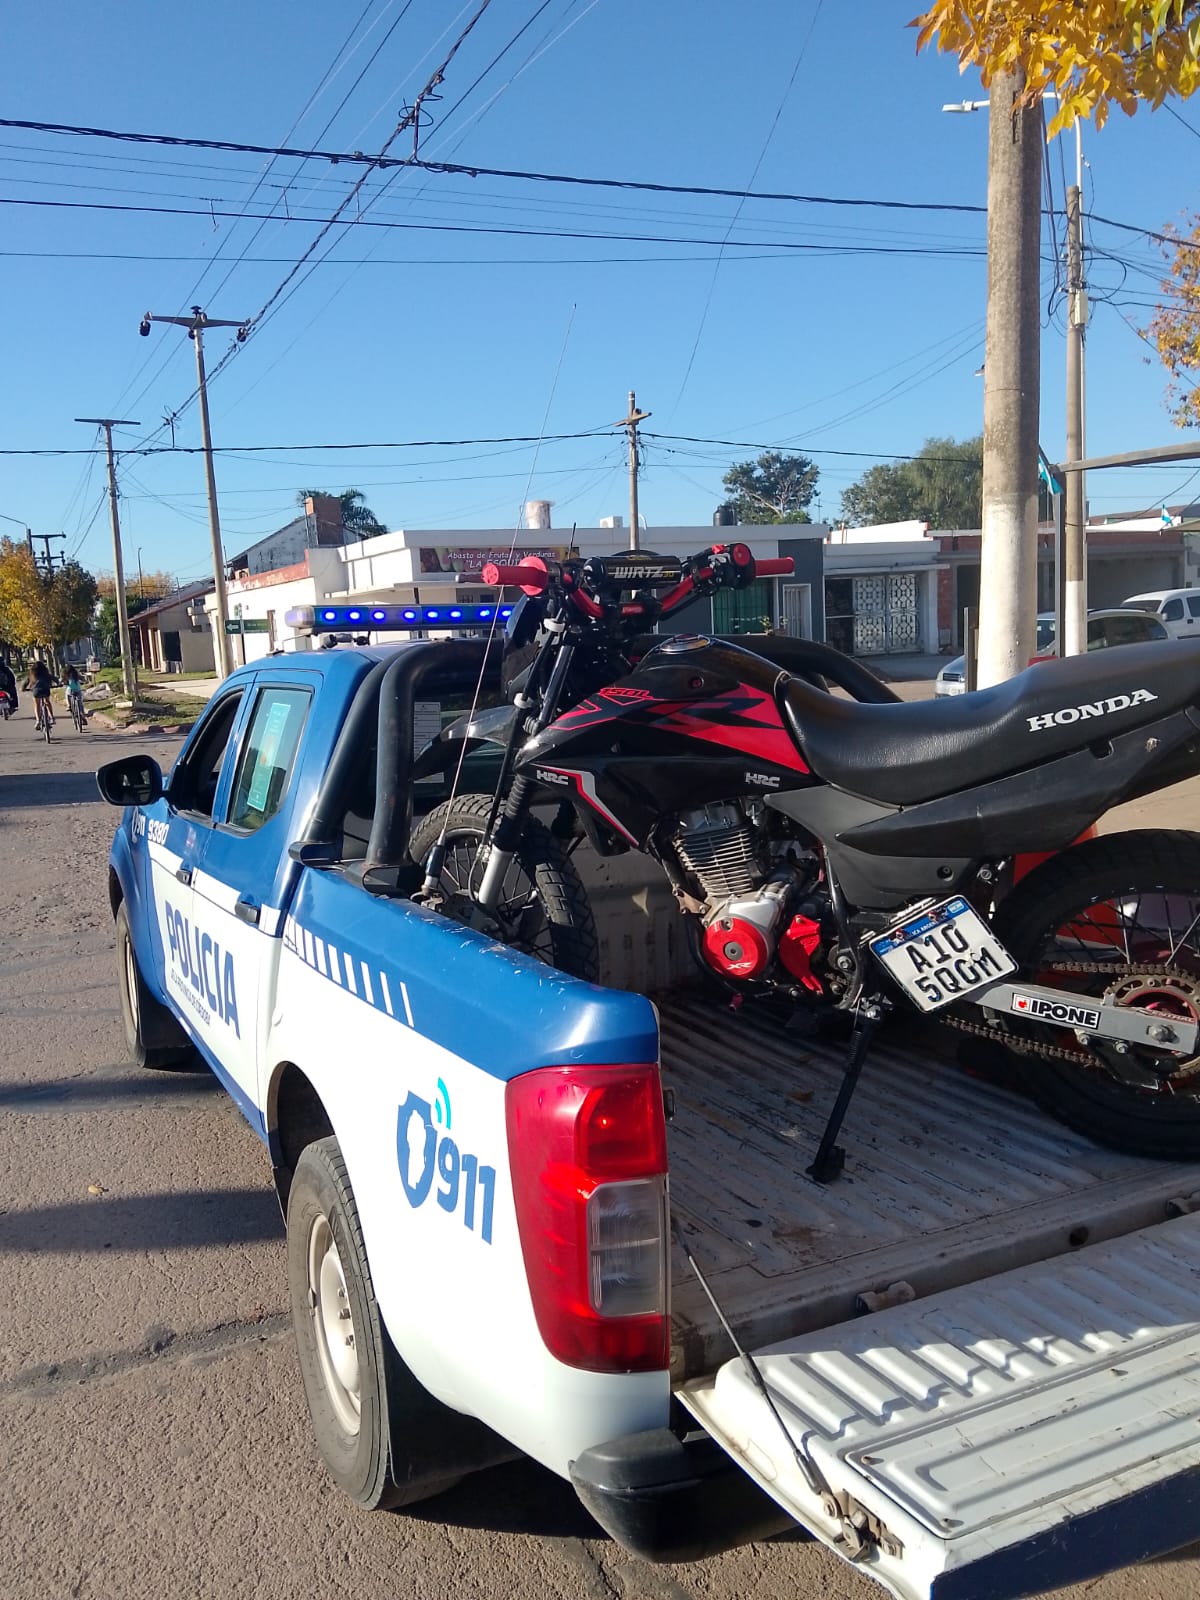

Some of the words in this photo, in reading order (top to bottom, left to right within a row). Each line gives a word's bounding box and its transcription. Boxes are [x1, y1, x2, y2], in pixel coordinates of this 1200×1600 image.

[614, 566, 664, 579] WIRTZ
[1026, 689, 1158, 732] HONDA
[536, 769, 569, 785] HRC
[745, 772, 780, 787] HRC
[905, 924, 969, 974] A10
[165, 900, 241, 1041] POLICIA
[726, 962, 752, 970] XR
[915, 947, 1003, 1003] 5QGM
[1031, 999, 1097, 1026] IPONE
